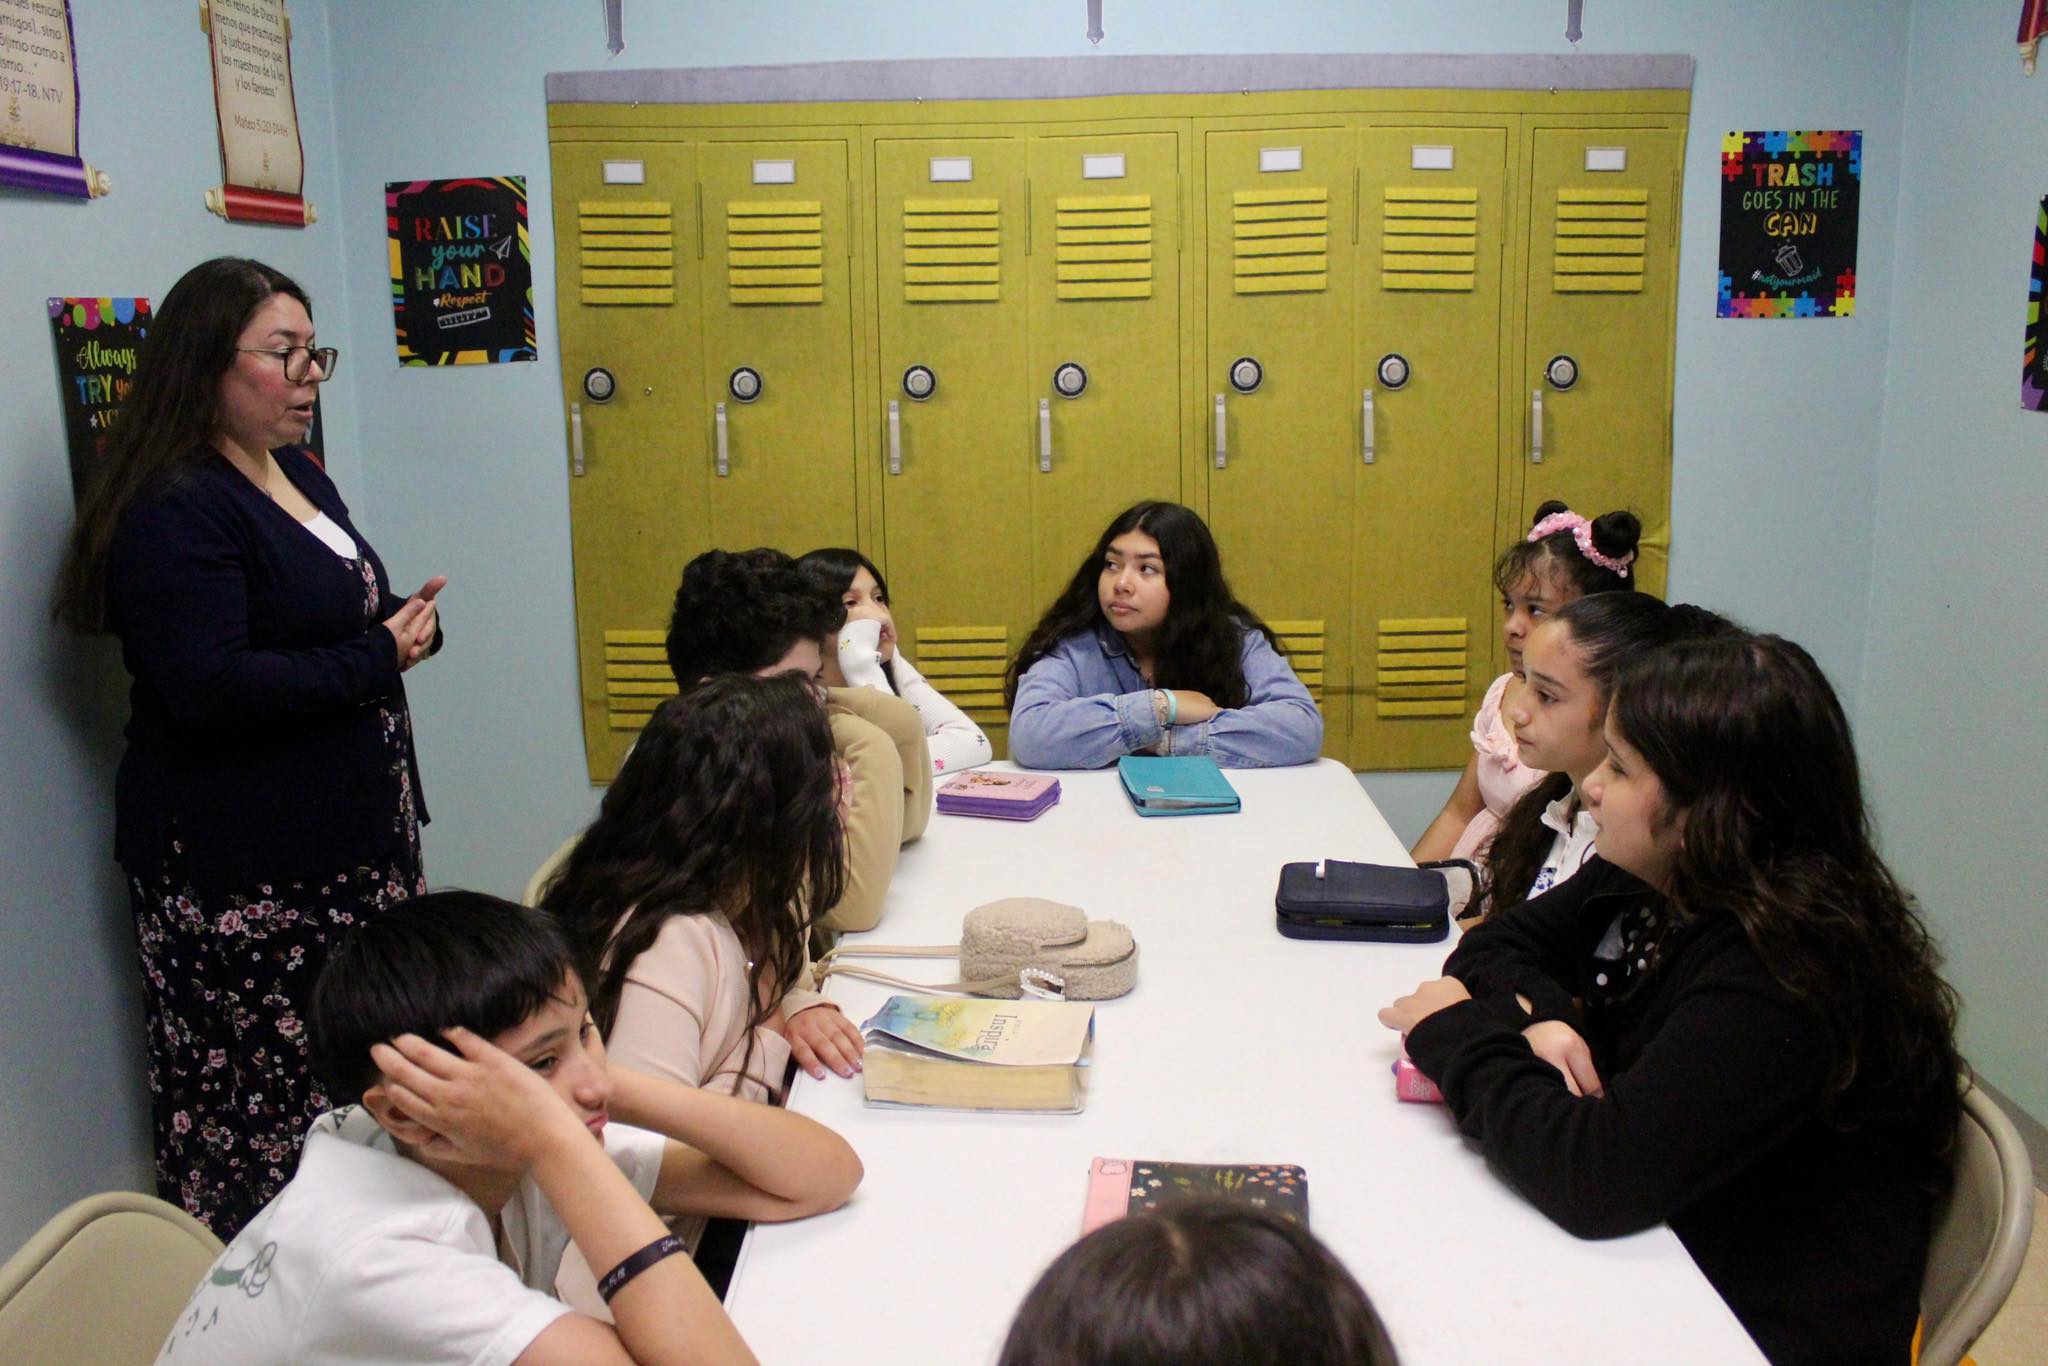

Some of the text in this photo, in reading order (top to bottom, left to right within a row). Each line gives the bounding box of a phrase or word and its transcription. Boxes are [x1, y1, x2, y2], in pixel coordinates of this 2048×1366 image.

[252, 3, 260, 18] de
[41, 24, 62, 40] sino
[215, 13, 238, 29] menos
[239, 21, 251, 36] que
[30, 44, 58, 60] como
[221, 47, 232, 66] los
[233, 58, 261, 75] maestros
[262, 63, 270, 77] de
[270, 62, 276, 80] la
[252, 45, 271, 60] mejor
[235, 77, 240, 92] y
[240, 74, 251, 91] los
[42, 87, 63, 104] NTV
[234, 113, 255, 130] Mateo
[1752, 163, 1833, 188] TRASH
[1742, 188, 1840, 210] GOES IN THE
[415, 214, 498, 240] RAISE
[1763, 210, 1817, 237] CAN
[431, 243, 487, 270] your
[415, 262, 506, 290] HAND
[76, 340, 137, 375] Always
[75, 373, 112, 405] TRY
[976, 1014, 1018, 1051] Inspira
